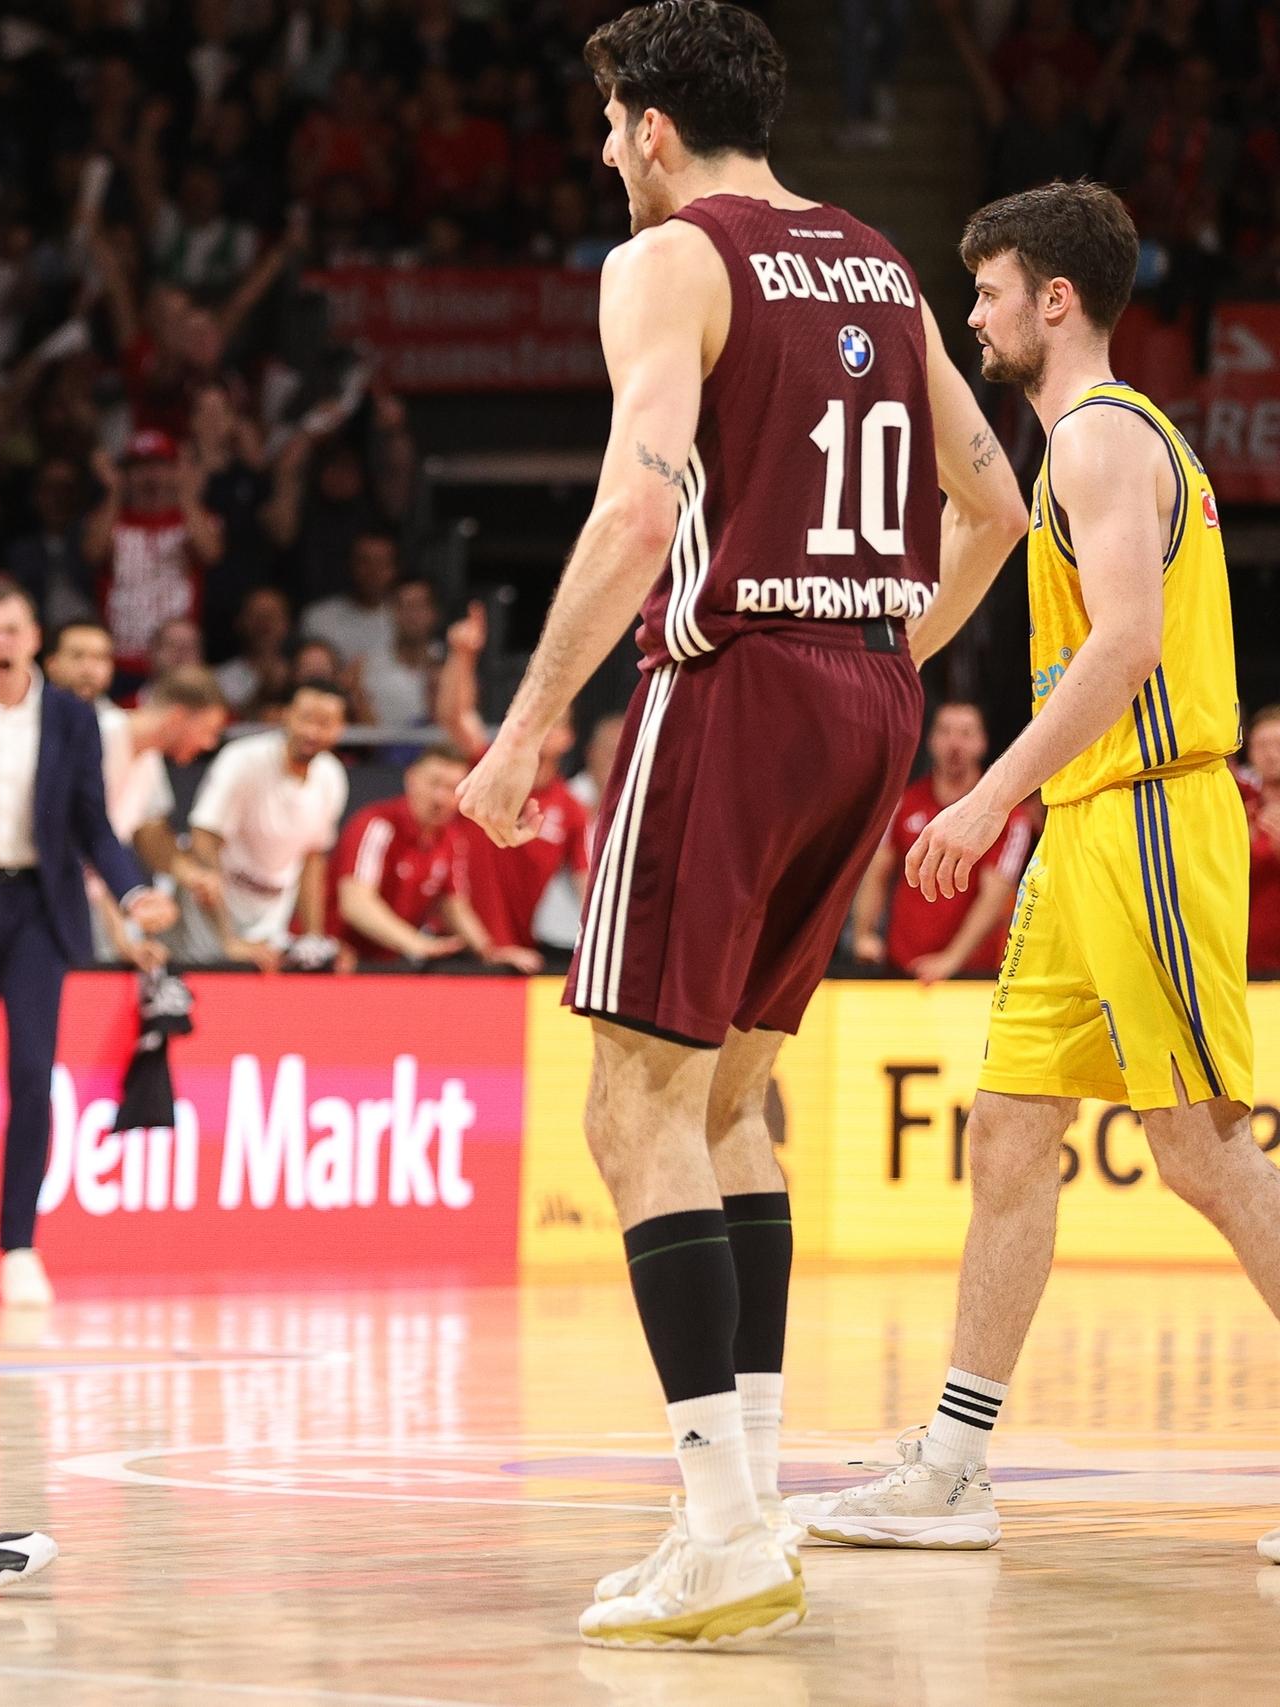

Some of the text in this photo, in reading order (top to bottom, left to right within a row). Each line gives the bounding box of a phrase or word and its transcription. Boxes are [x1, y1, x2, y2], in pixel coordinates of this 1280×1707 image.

[749, 251, 916, 308] BOLMARO
[806, 399, 911, 555] 10
[1007, 933, 1025, 978] waste
[218, 1053, 476, 1210] Markt
